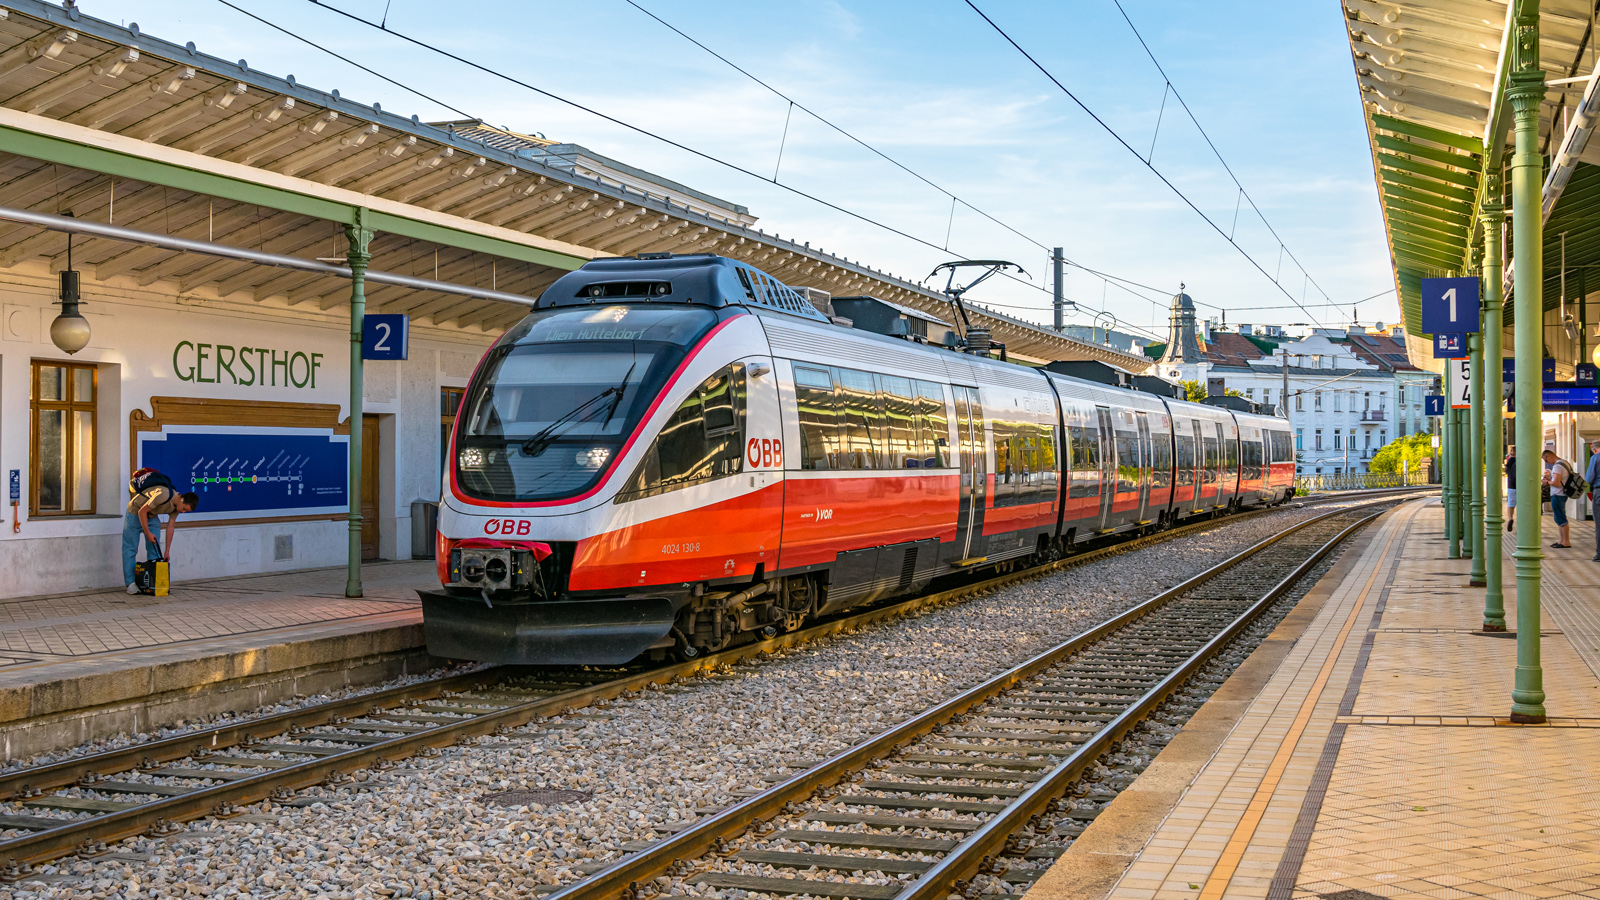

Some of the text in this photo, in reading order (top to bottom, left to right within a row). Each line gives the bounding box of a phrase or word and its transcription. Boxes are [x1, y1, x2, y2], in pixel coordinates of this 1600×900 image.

[1441, 287, 1457, 323] 1
[374, 322, 392, 352] 2
[545, 327, 646, 341] Wien Hütteldorf
[173, 340, 324, 389] GERSTHOF
[1461, 361, 1471, 381] 5
[1462, 384, 1471, 403] 4
[1431, 398, 1438, 413] 1
[747, 437, 783, 469] ÖBB
[484, 518, 532, 536] ÖBB
[661, 542, 701, 555] 4024 130-8
